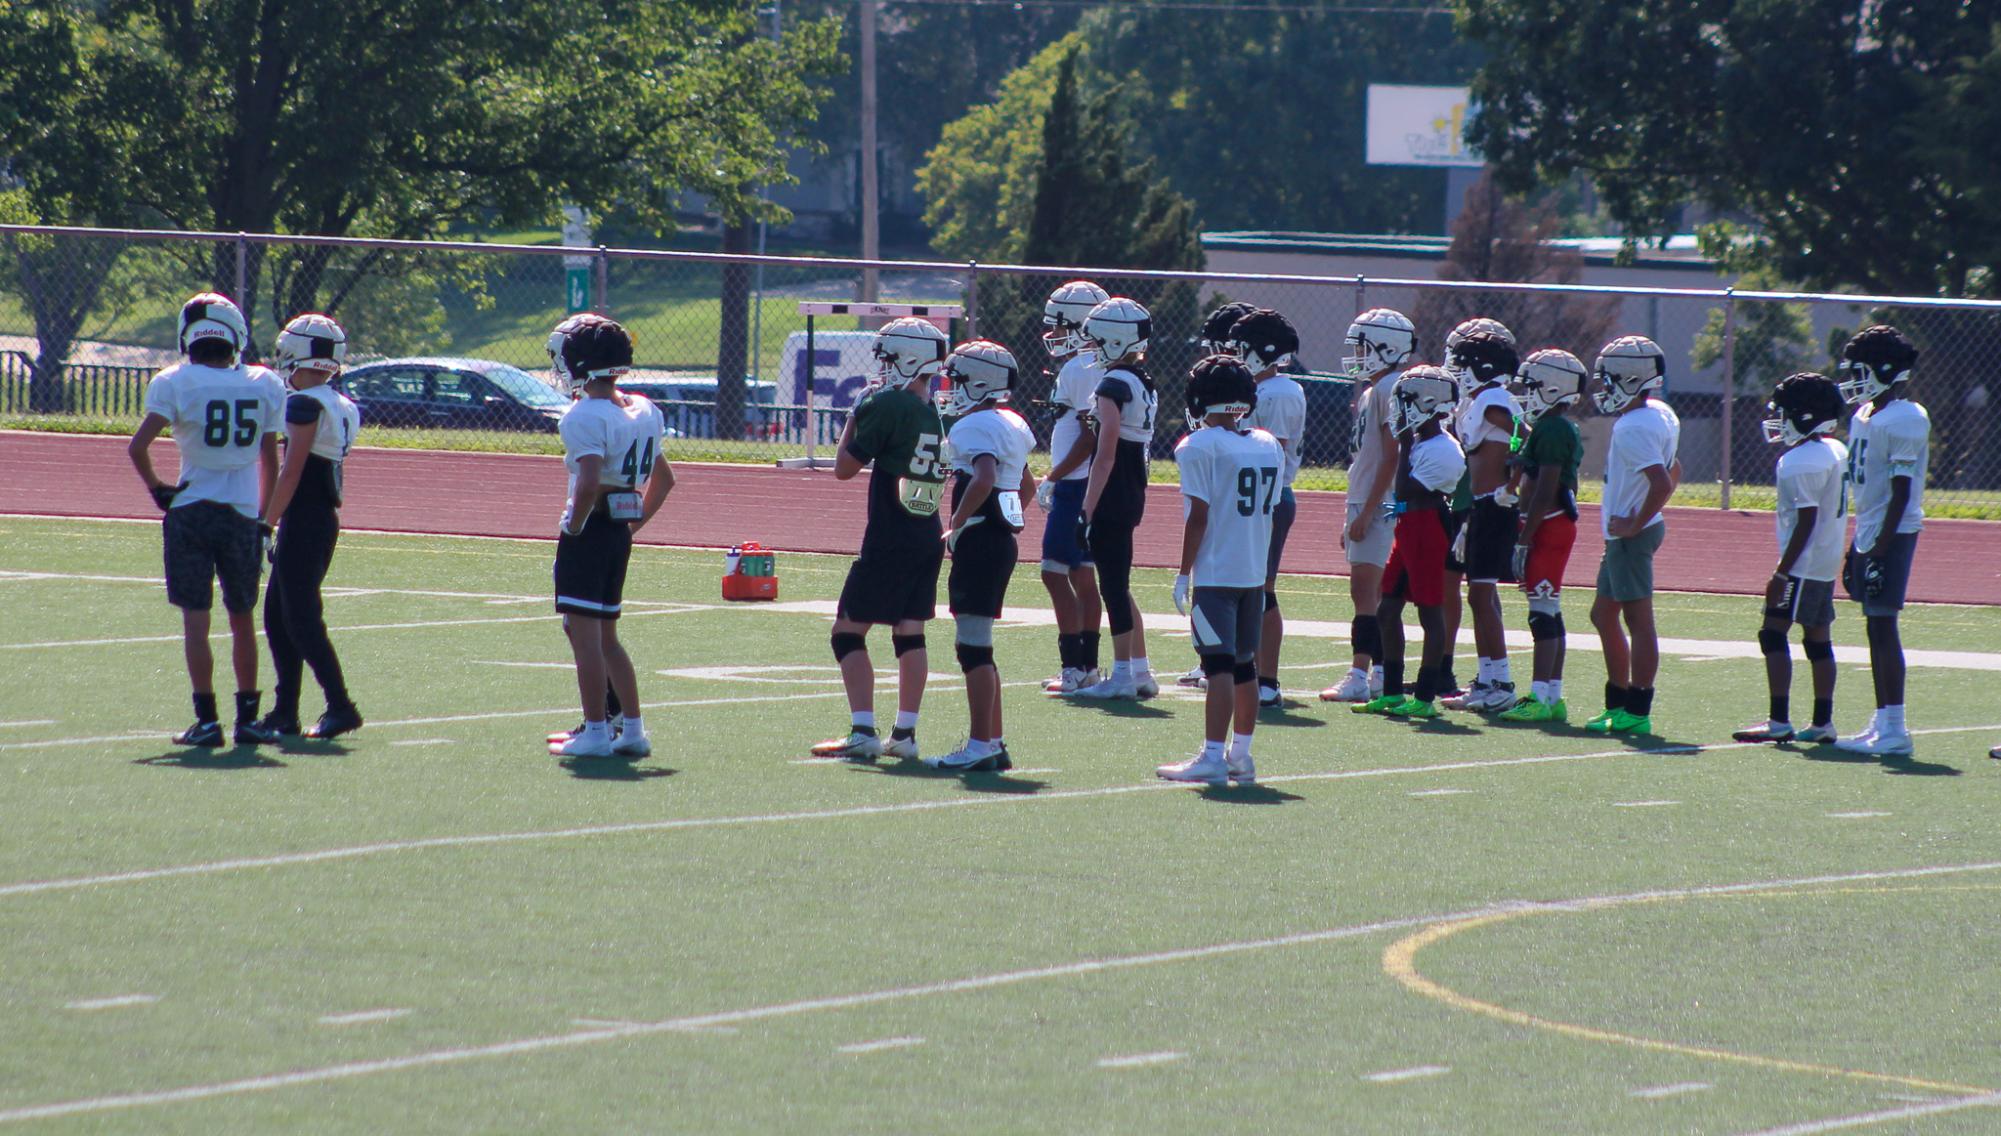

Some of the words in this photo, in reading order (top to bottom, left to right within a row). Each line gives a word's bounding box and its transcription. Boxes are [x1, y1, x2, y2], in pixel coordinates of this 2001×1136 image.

[204, 399, 259, 448] 85
[620, 436, 654, 486] 44
[1236, 466, 1279, 517] 97
